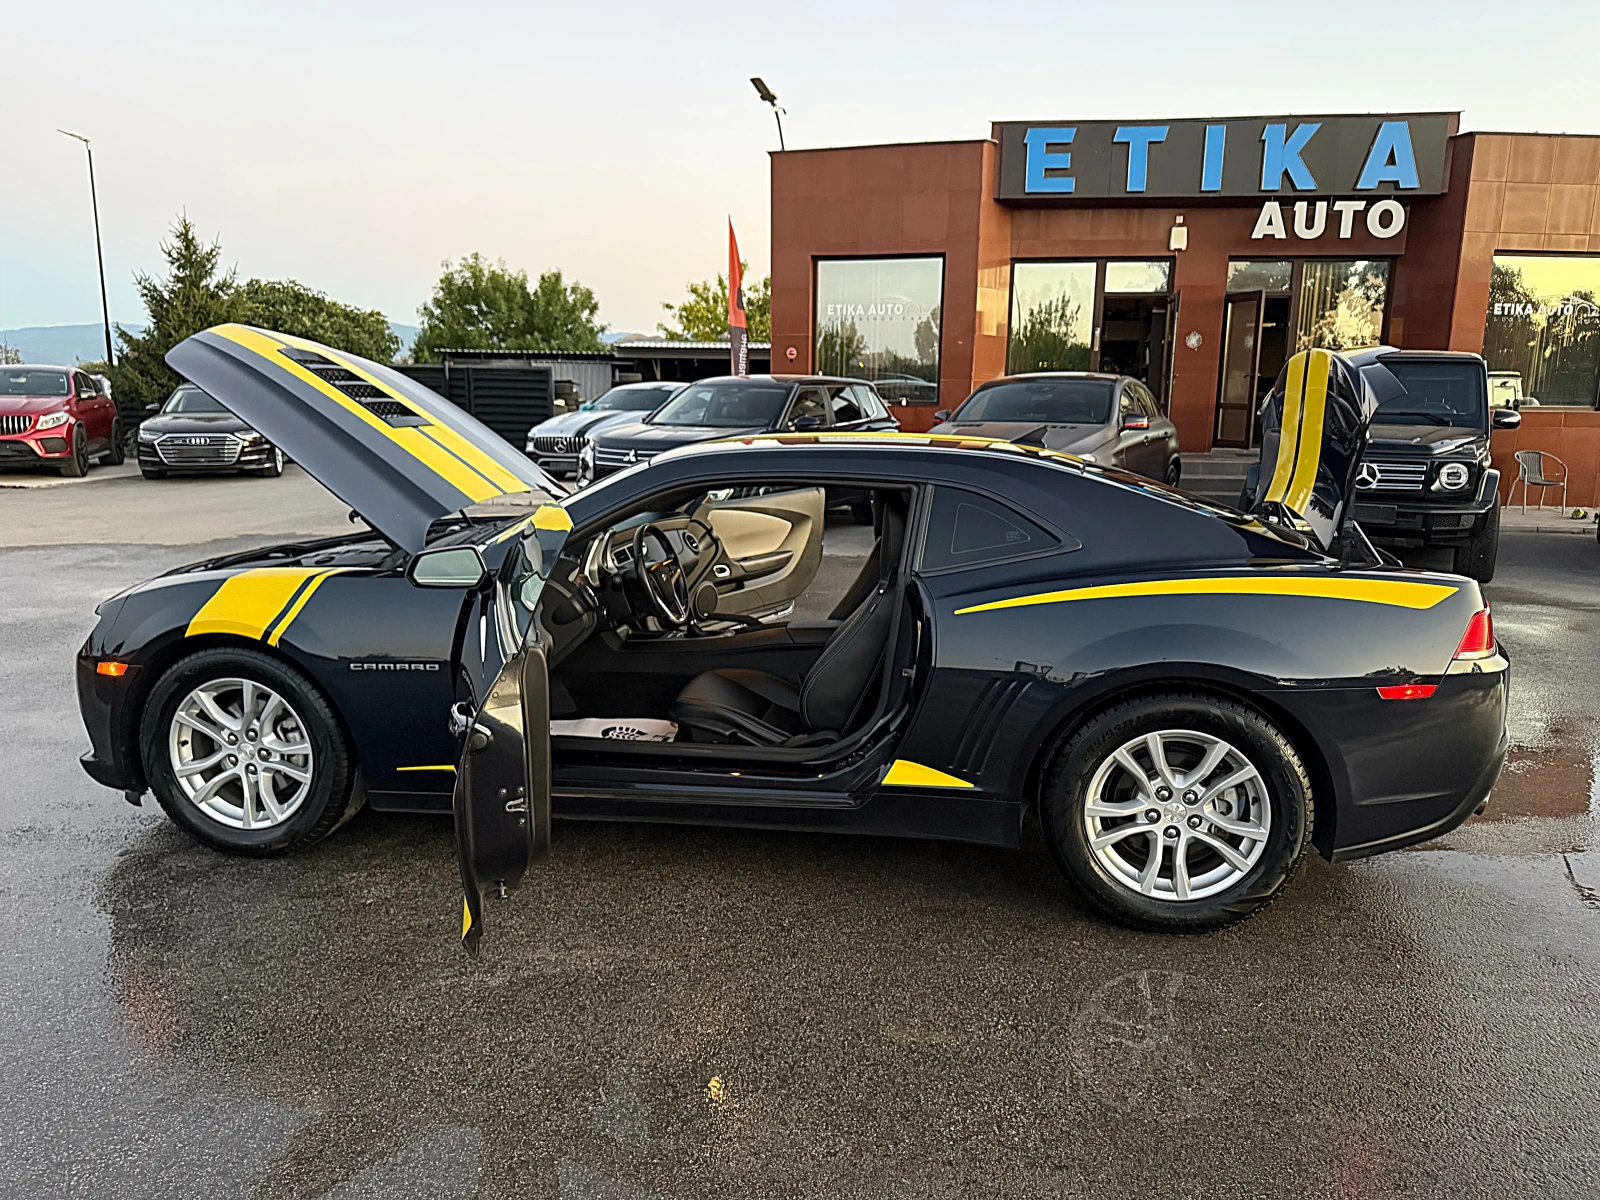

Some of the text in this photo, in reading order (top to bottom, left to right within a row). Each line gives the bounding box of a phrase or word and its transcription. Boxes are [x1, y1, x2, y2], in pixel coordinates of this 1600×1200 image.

[1024, 120, 1420, 193] ETIKA
[1251, 199, 1406, 240] AUTO
[827, 303, 904, 316] ETIKA AUTO
[1493, 302, 1574, 316] ETIKA AUTO
[349, 663, 440, 671] CAMARO
